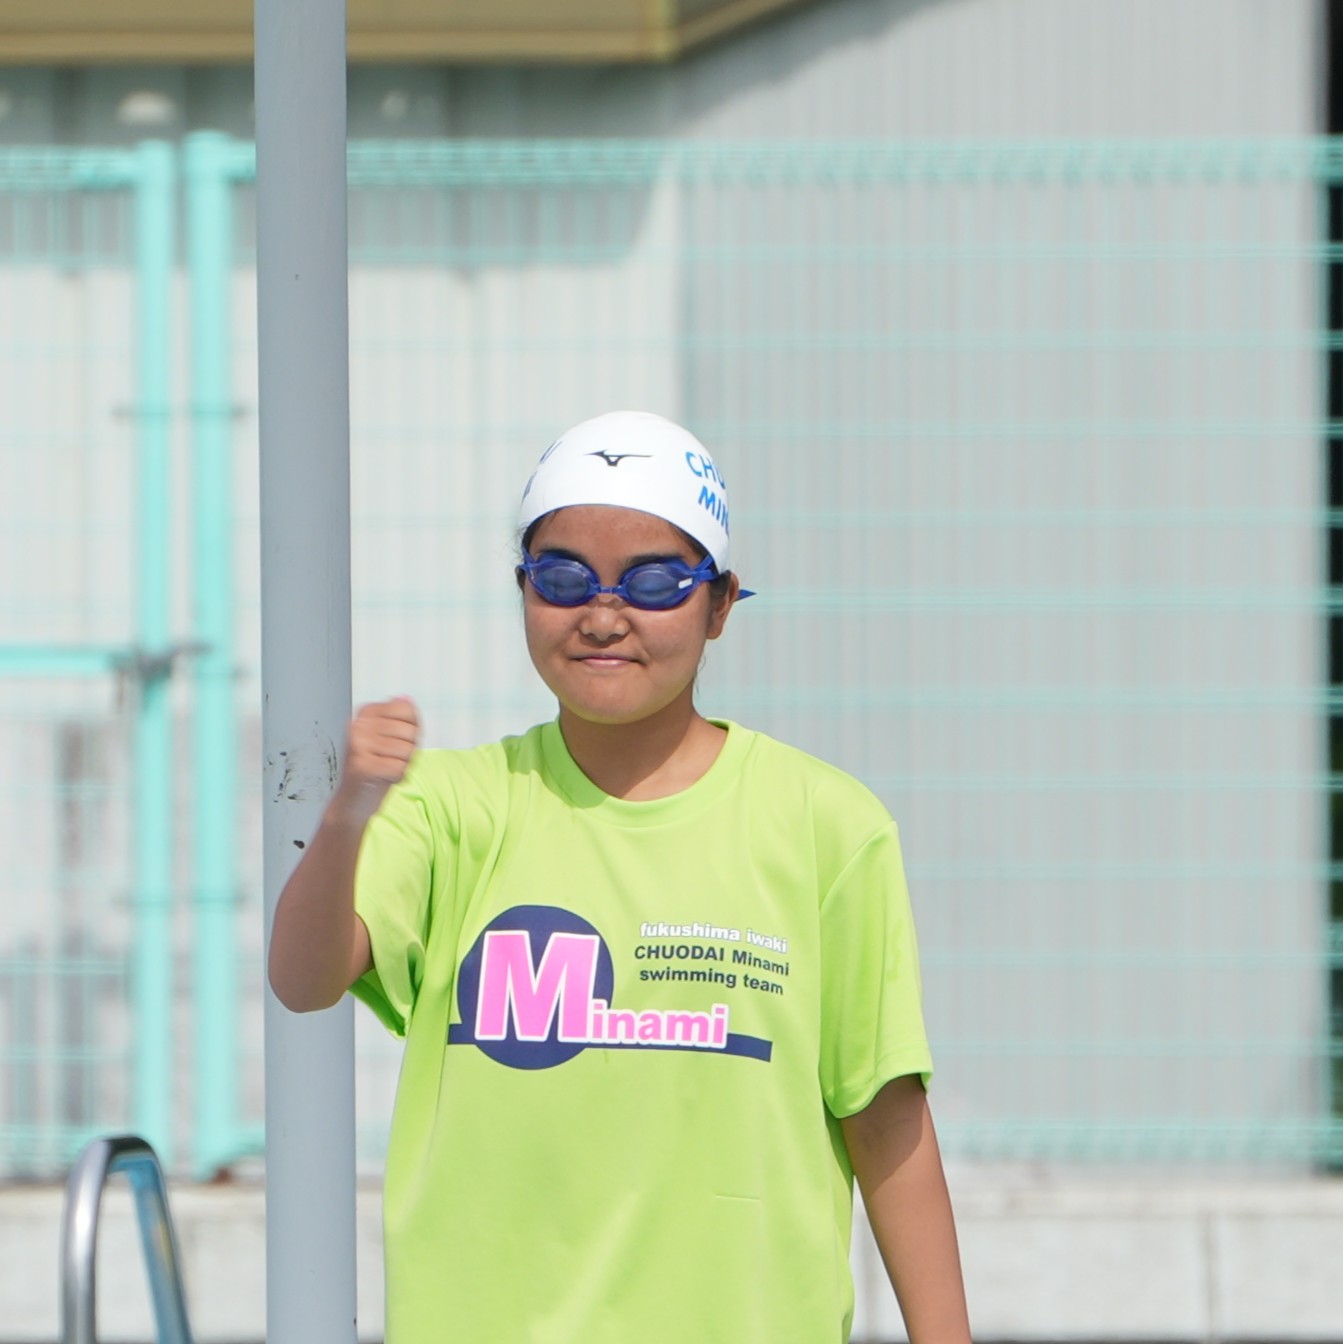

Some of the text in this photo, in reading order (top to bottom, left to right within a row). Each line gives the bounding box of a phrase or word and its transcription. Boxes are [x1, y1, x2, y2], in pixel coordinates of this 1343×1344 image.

[640, 922, 788, 953] fukushima iwaki
[634, 944, 790, 976] CHUODAI Minami
[475, 930, 729, 1048] Minami
[639, 966, 784, 996] swimming team
